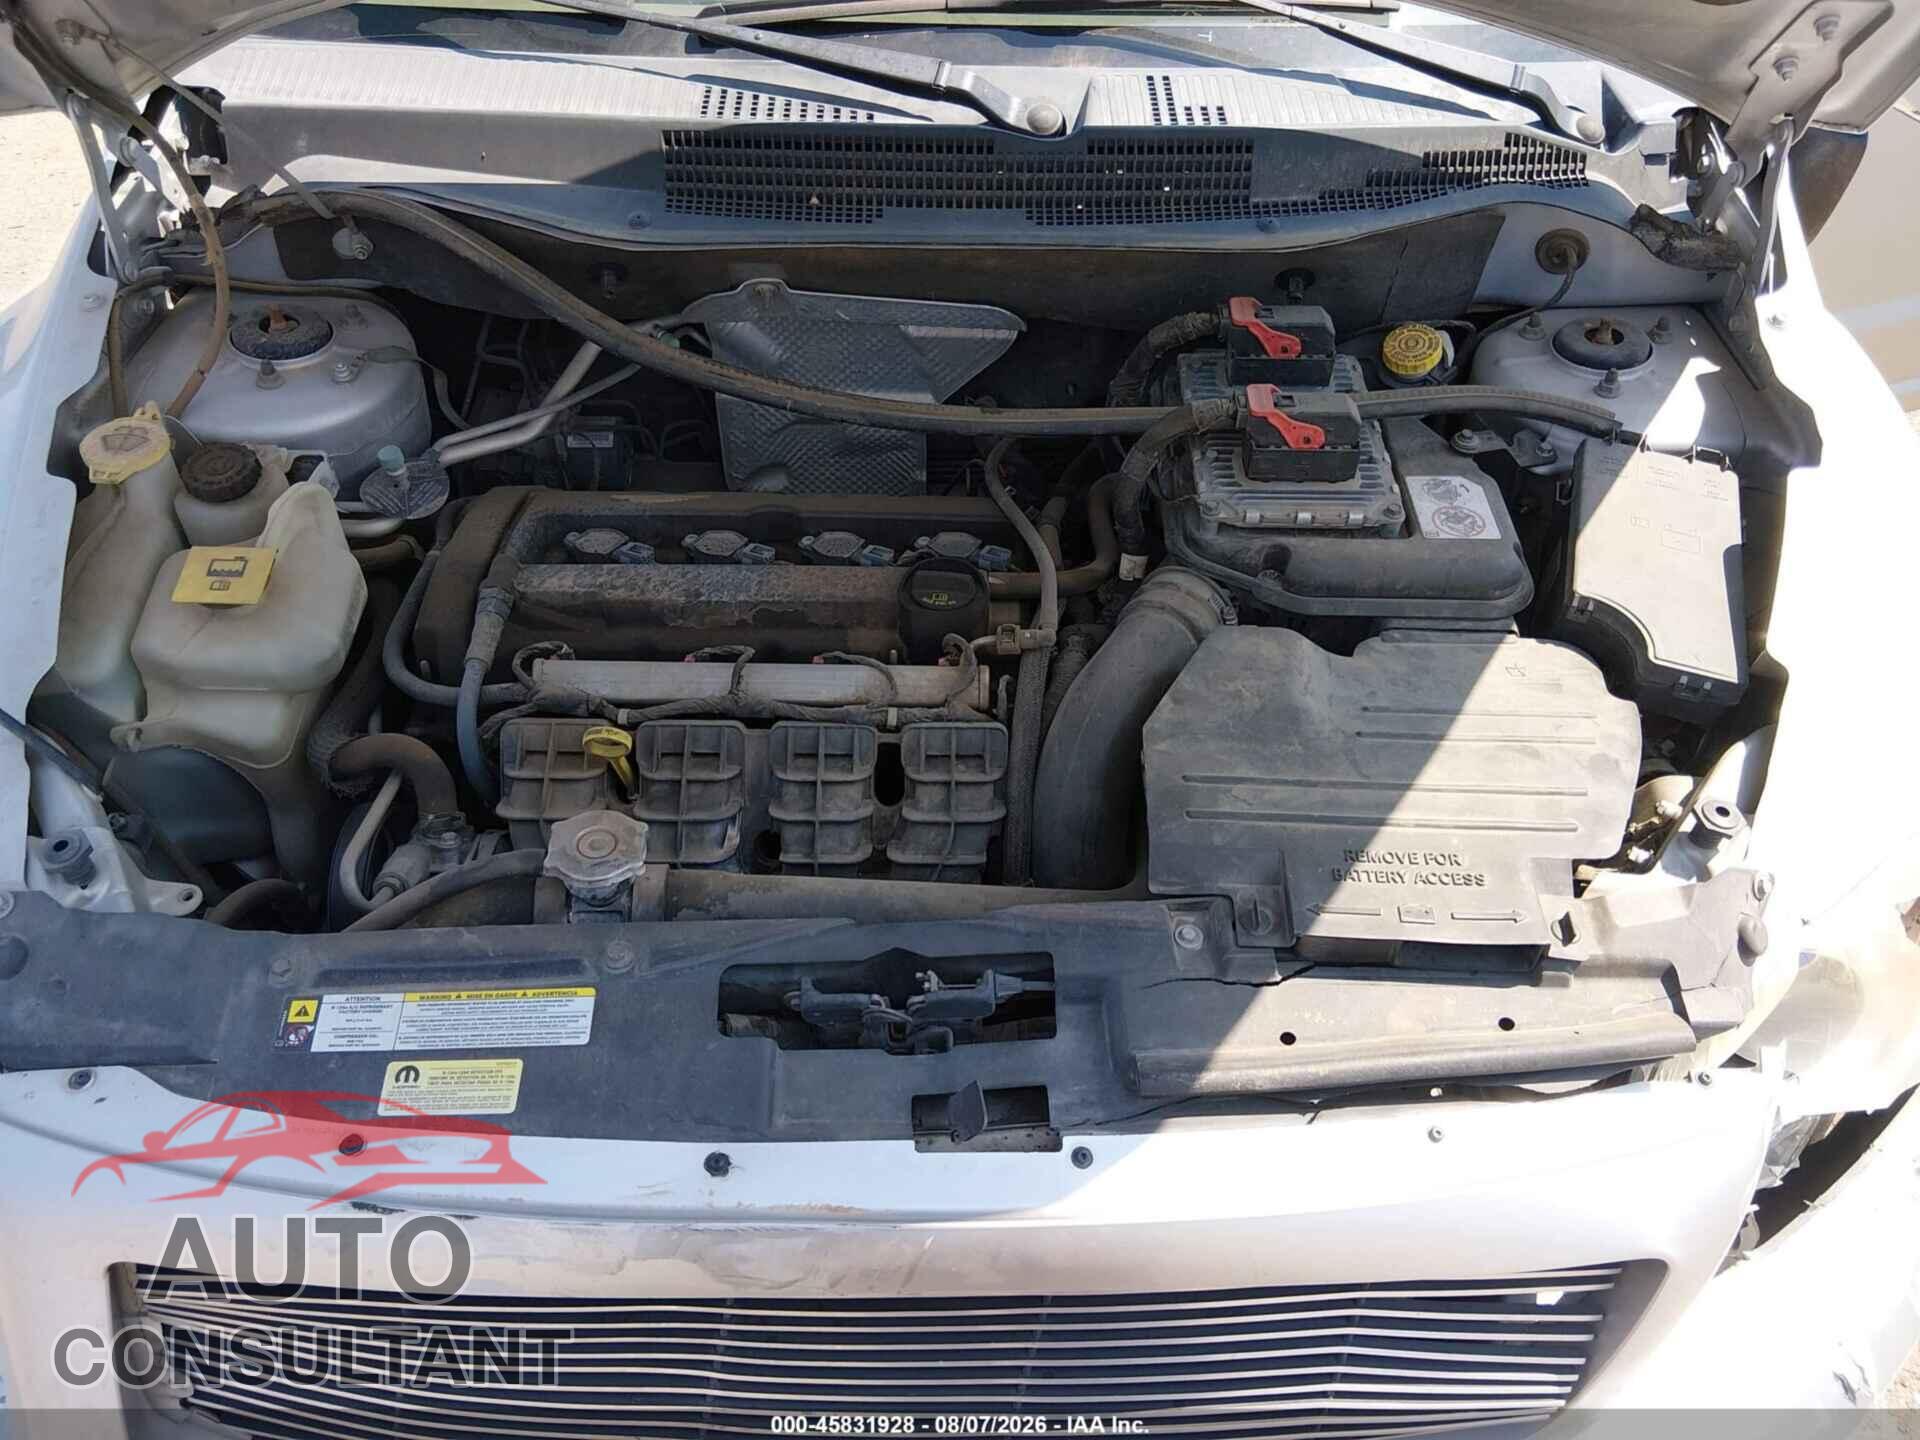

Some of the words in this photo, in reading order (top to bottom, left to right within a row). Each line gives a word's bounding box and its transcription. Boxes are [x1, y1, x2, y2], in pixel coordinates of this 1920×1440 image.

[1343, 850, 1420, 866] REMOVE
[1424, 852, 1463, 867] FOR
[1331, 867, 1408, 885] BATTERY
[1414, 871, 1486, 887] ACCESS
